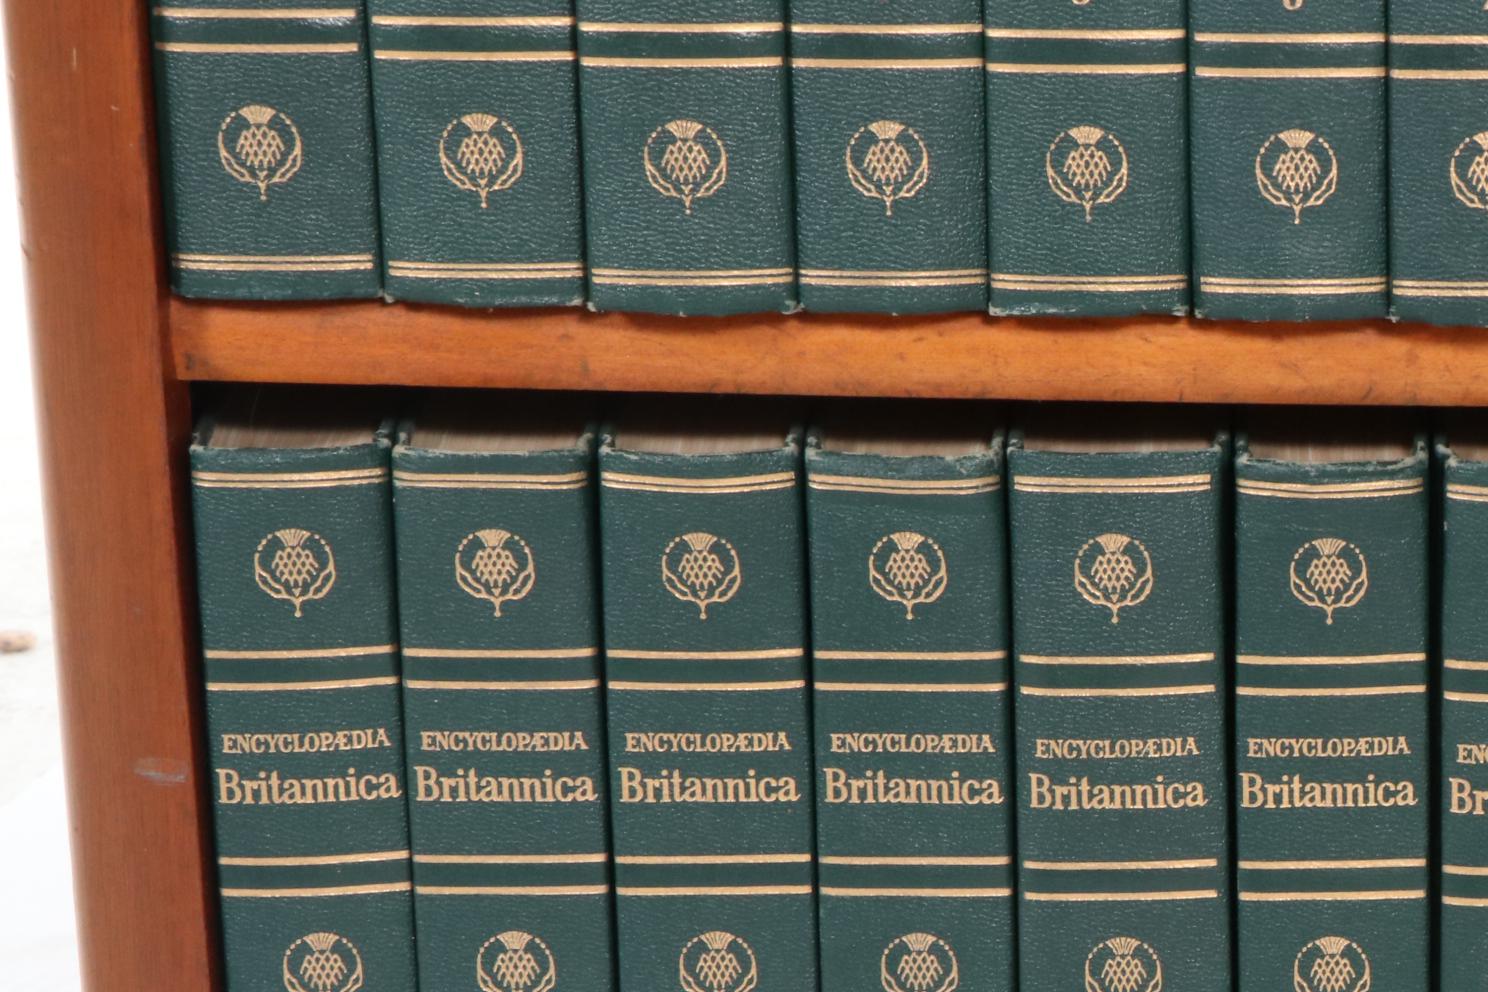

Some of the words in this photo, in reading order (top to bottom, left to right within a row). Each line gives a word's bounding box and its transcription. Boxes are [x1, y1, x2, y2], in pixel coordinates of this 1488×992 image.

[216, 768, 402, 804] Britannica
[415, 766, 597, 802] Britannica
[618, 767, 800, 803] Britannica
[822, 768, 1004, 804] Britannica
[1028, 773, 1208, 810] Britannica
[1239, 773, 1418, 808] Britannica
